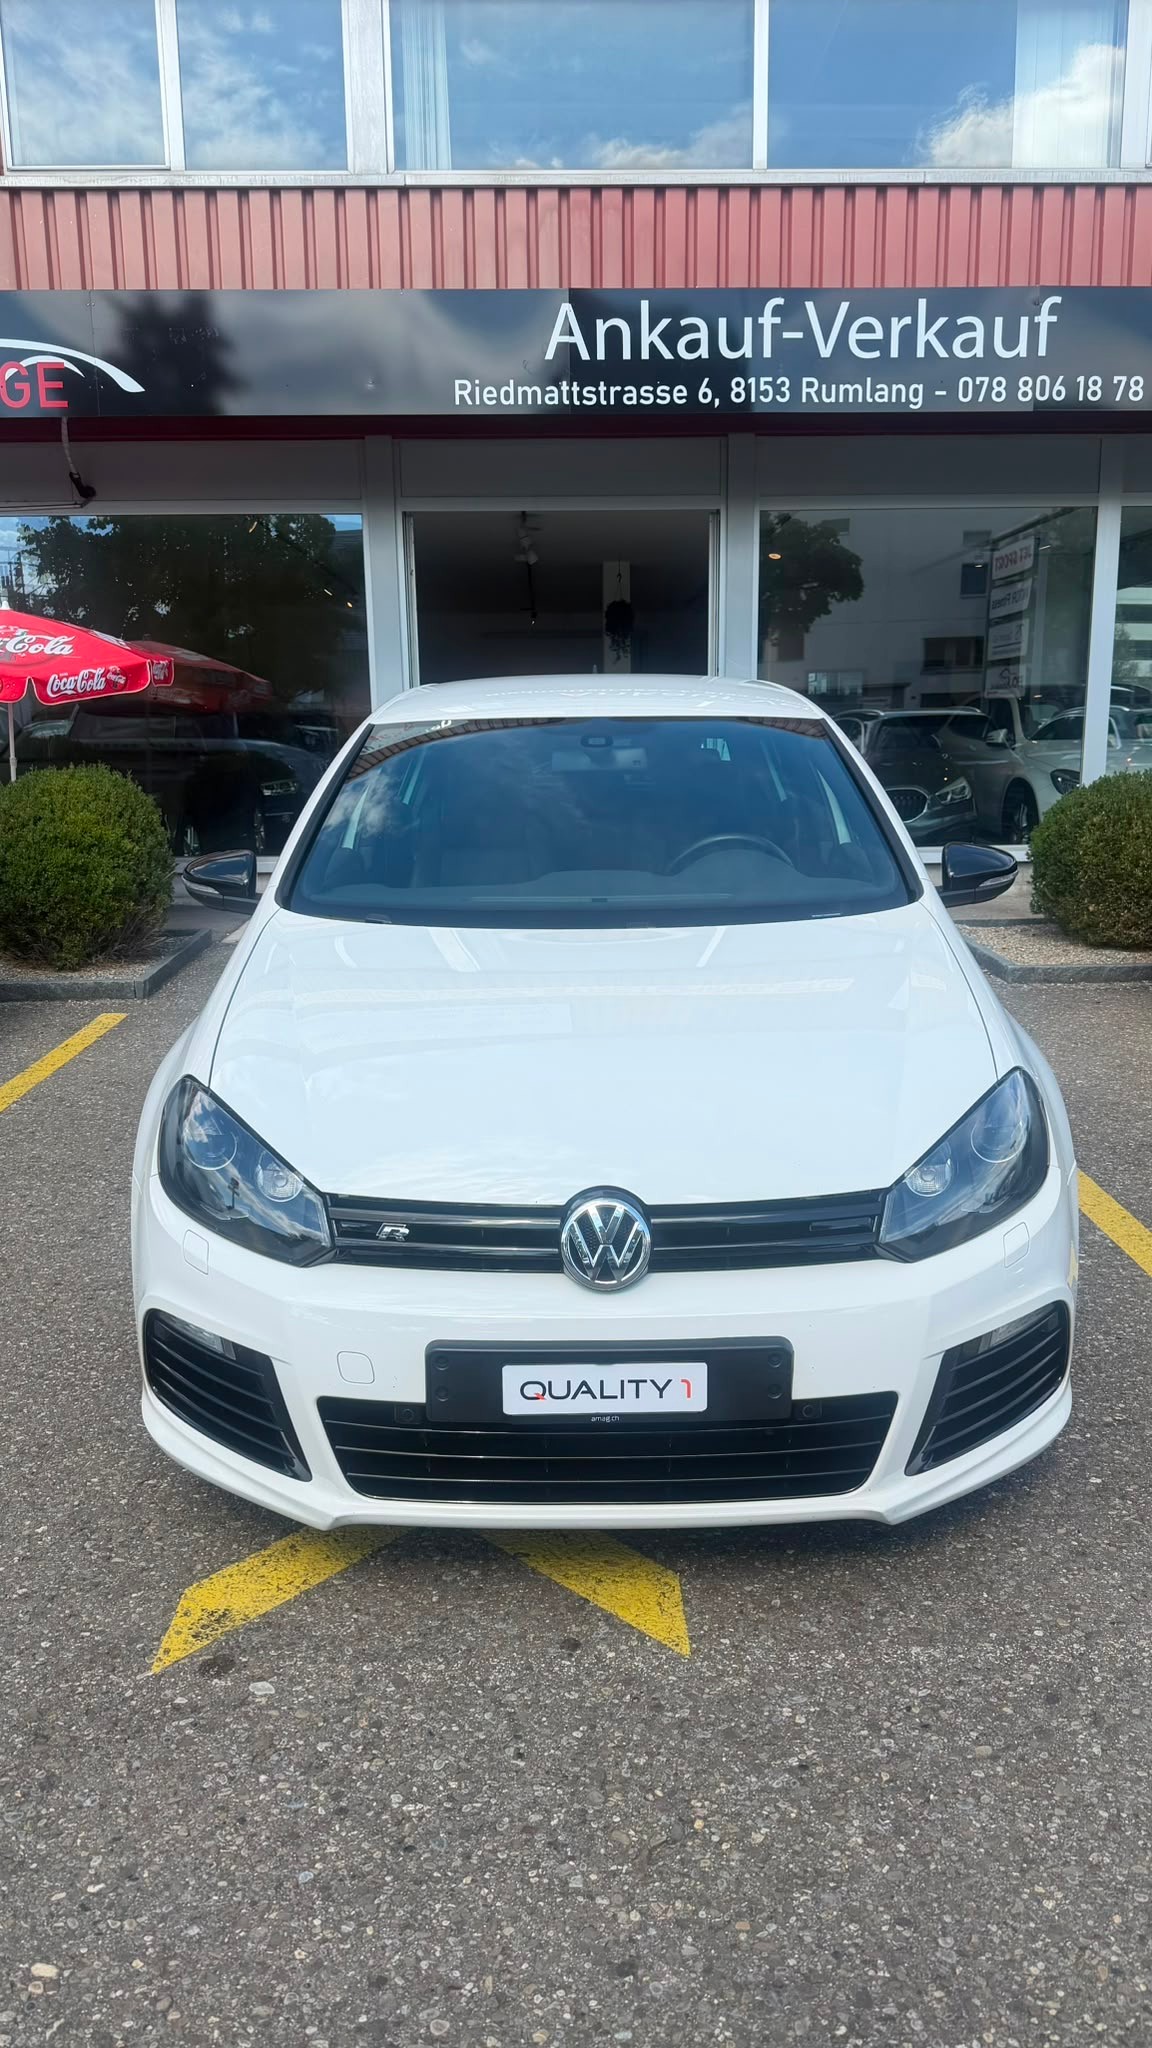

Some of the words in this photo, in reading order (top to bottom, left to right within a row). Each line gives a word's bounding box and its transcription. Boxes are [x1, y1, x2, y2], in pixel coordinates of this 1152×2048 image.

[544, 296, 1062, 361] Ankauf-Verkauf
[0, 361, 69, 408] GE
[454, 379, 688, 406] Riedmattstrasse
[698, 377, 720, 408] 6,
[730, 376, 791, 404] 8153
[802, 376, 924, 409] Rumlang
[957, 376, 1007, 403] 078
[1017, 375, 1066, 402] 806
[1076, 375, 1102, 402] 18
[1112, 375, 1144, 402] 78
[376, 1222, 410, 1241] R
[519, 1378, 673, 1401] QUALITY
[680, 1378, 692, 1400] 1
[590, 1414, 620, 1423] amag.ch
